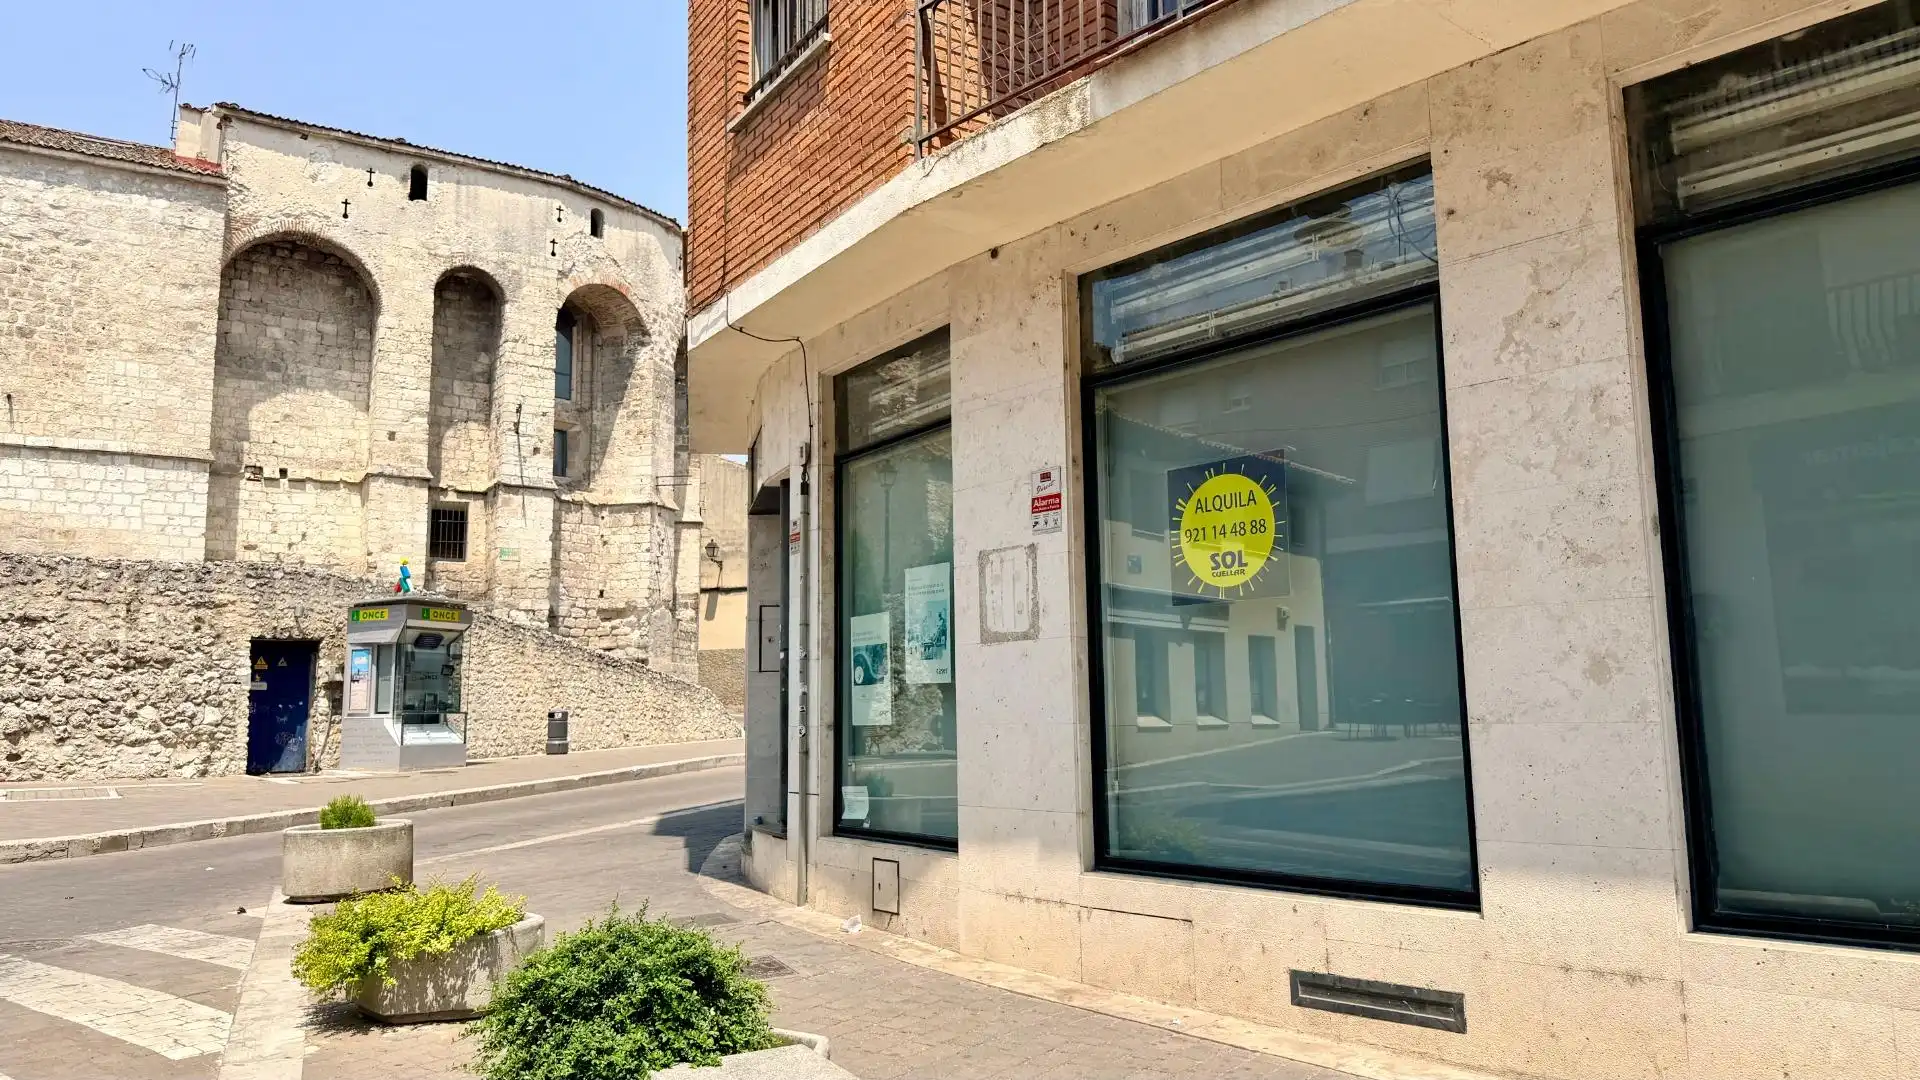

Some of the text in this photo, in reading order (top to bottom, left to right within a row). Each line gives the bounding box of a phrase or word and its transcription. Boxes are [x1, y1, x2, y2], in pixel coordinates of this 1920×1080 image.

[1033, 497, 1060, 507] Alarma
[1195, 490, 1256, 514] ALQUILA
[1185, 518, 1267, 543] 921 14 48 88
[1210, 550, 1248, 571] SOL
[1211, 568, 1246, 578] CUELLAR
[362, 611, 385, 620] ONCE
[433, 611, 456, 621] ONCE
